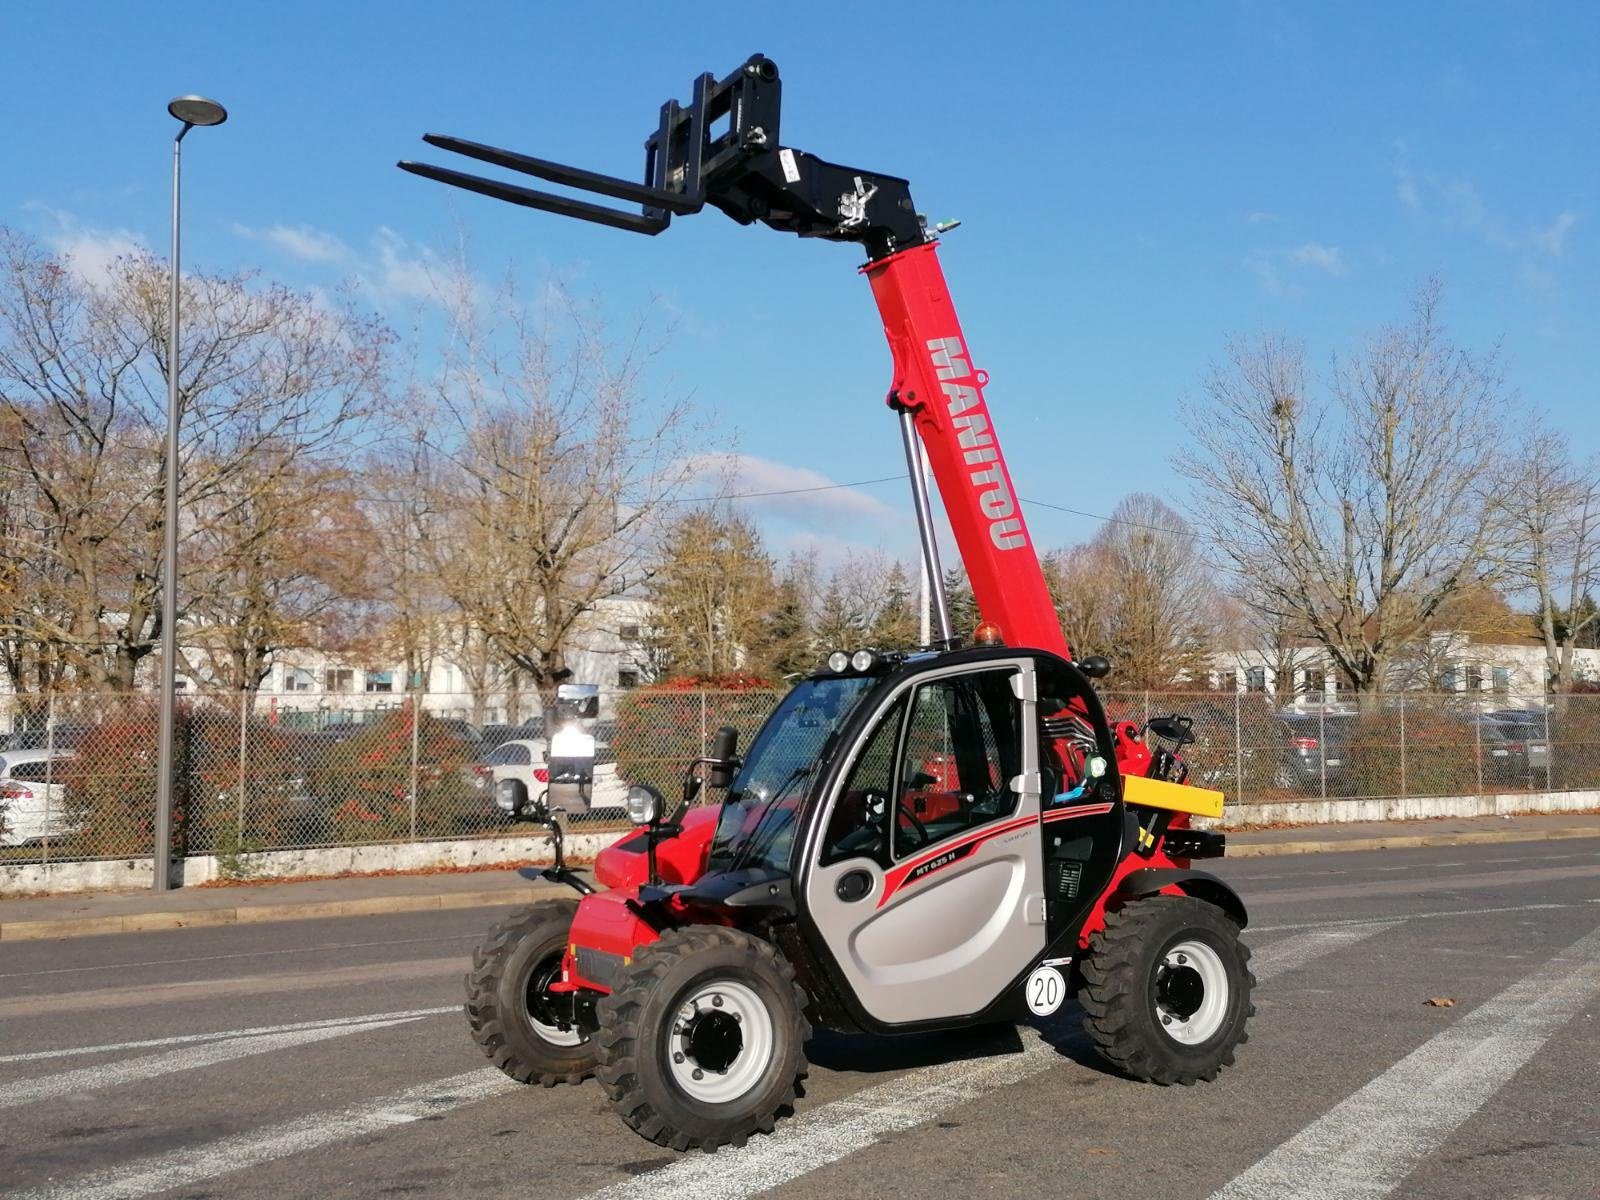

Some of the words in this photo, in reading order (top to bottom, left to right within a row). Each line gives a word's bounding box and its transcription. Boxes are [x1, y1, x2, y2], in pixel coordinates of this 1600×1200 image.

[926, 336, 1027, 551] MANITOU
[916, 864, 930, 876] MT
[1034, 977, 1058, 1007] 20
